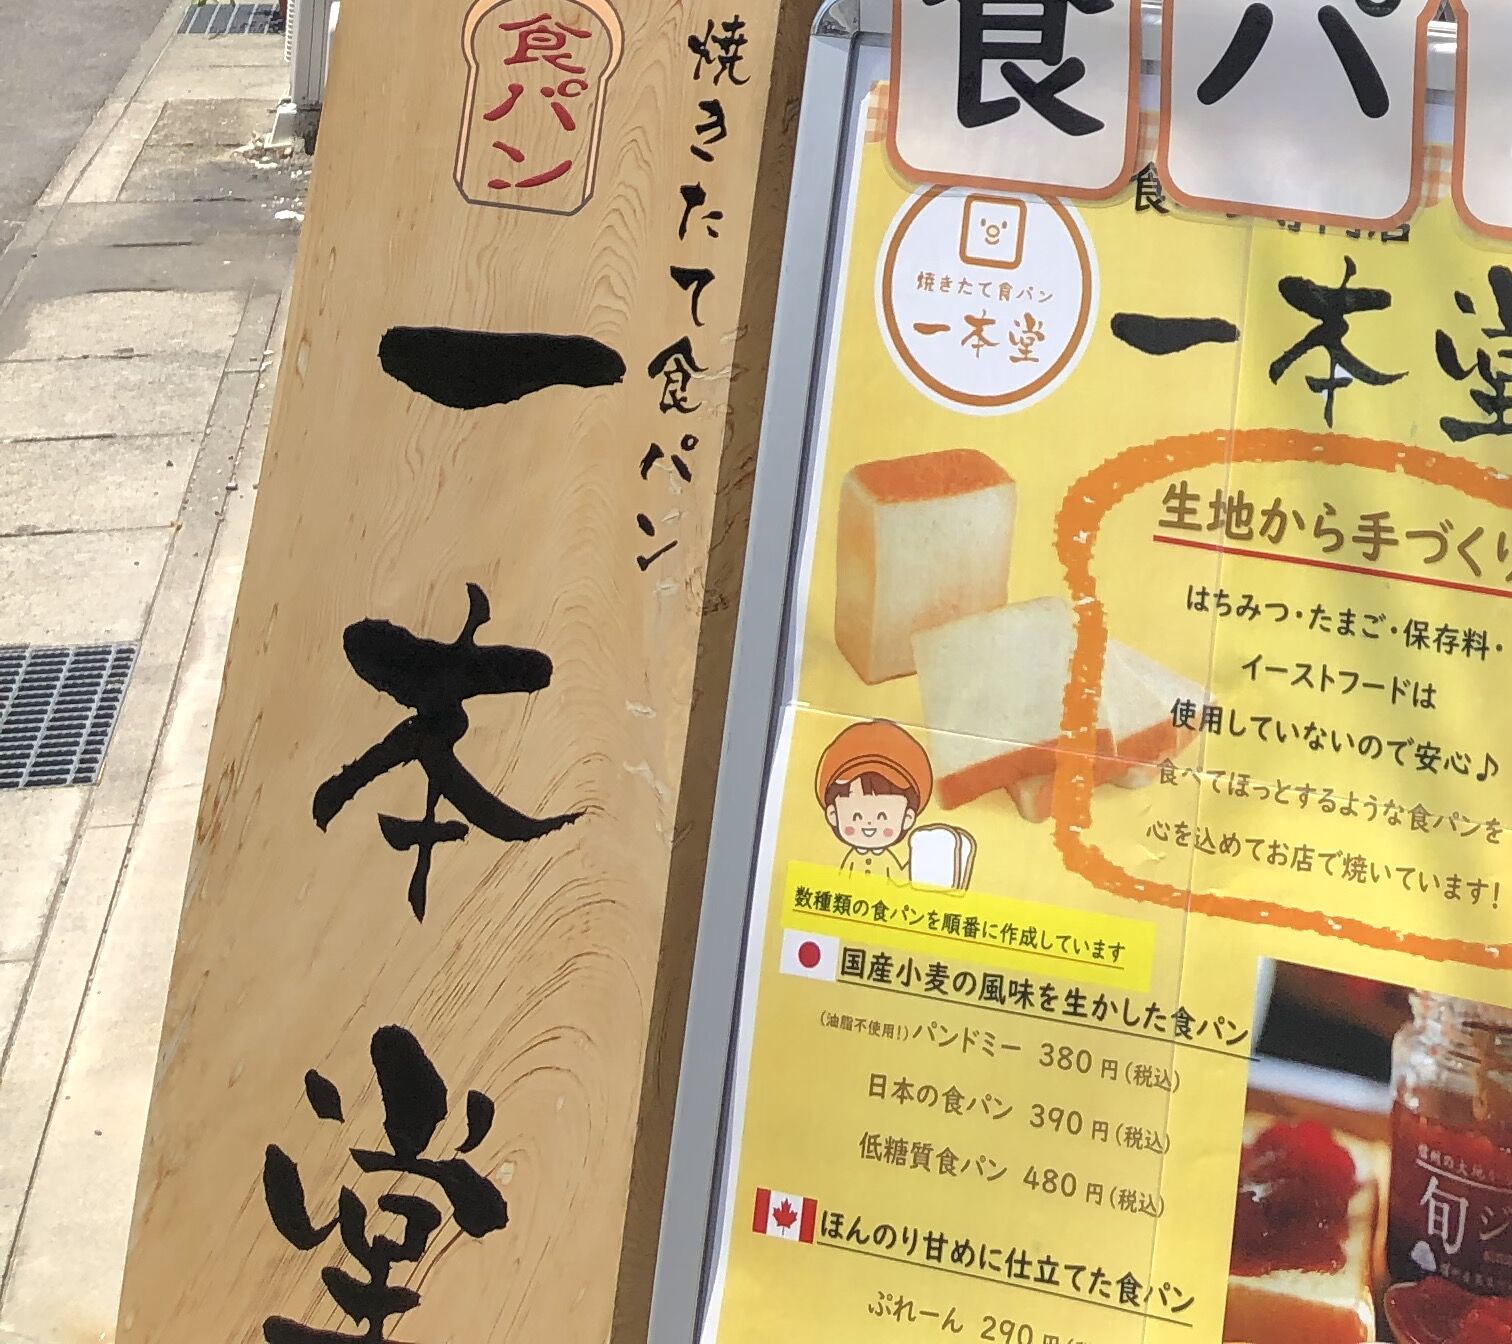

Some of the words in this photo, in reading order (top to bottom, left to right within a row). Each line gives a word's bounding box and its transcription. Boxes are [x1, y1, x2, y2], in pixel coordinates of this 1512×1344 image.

[483, 13, 593, 189] 食パン
[637, 14, 751, 572] 焼きたて食パン
[915, 270, 1055, 305] 焼きたて食パン
[912, 309, 1046, 364] 一本堂
[1240, 652, 1438, 711] イーストフードは
[262, 325, 627, 1344] 一本堂
[1157, 756, 1504, 844] 食べてほっとするような食パンを
[794, 885, 1126, 964] 数種類の食パンを順番に作成しています
[839, 946, 1251, 1047] 国産小麦の風味を生かした食パン
[913, 1022, 1022, 1056] パンドミー
[867, 1072, 1014, 1121] 日本の食パン
[859, 1130, 1009, 1182] 低糖質食パン
[820, 1209, 1197, 1314] ほんのり甘めに仕立てた食パン
[867, 1290, 965, 1334] ぷれーん
